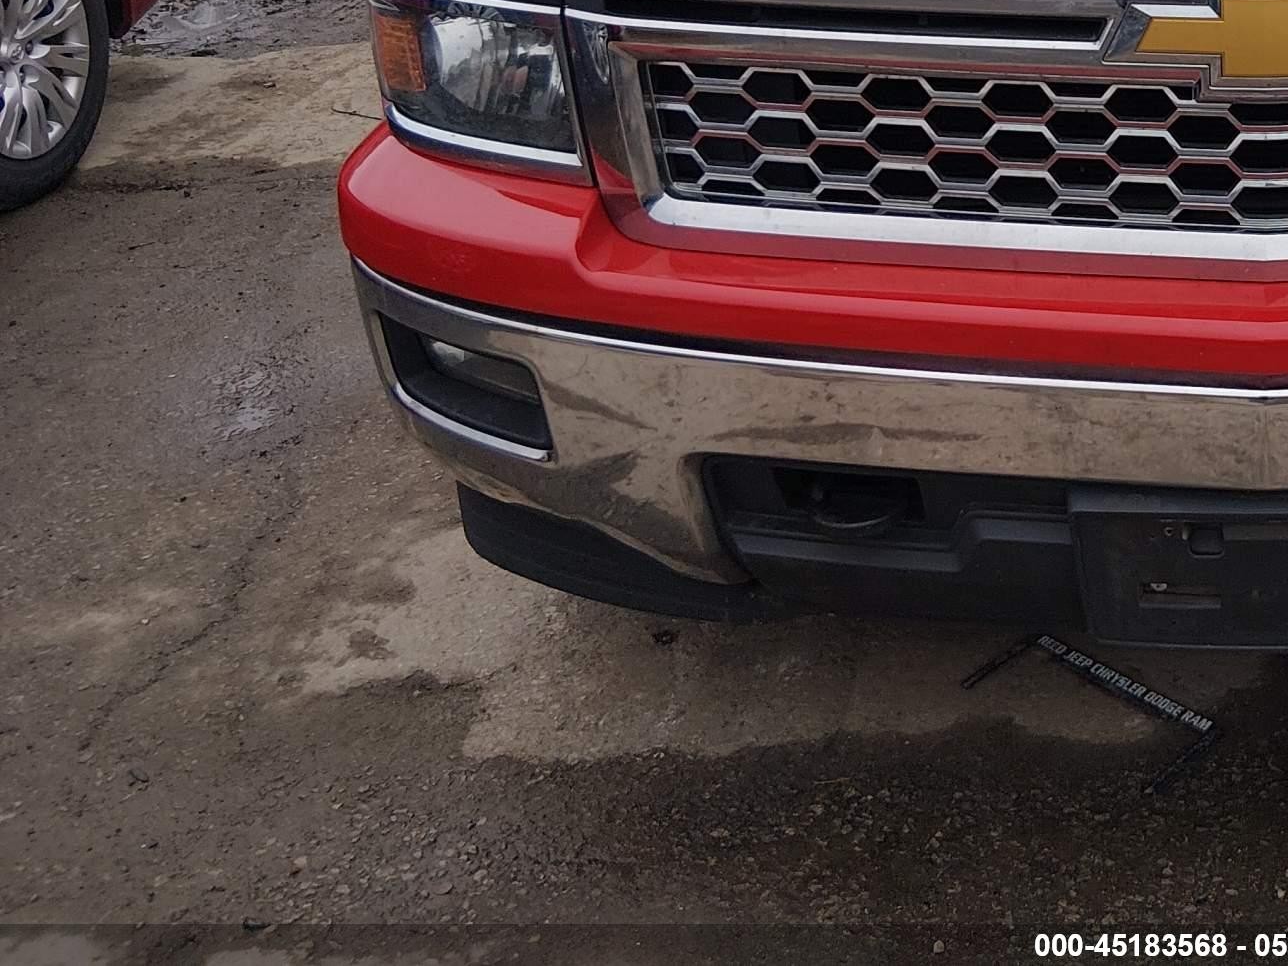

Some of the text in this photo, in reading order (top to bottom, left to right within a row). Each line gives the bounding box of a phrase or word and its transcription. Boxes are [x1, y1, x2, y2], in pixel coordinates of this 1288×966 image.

[1063, 651, 1092, 668] JEEP
[1090, 664, 1146, 698] CHRYSLER
[1144, 691, 1185, 717] DODGE
[1180, 710, 1213, 731] RAM
